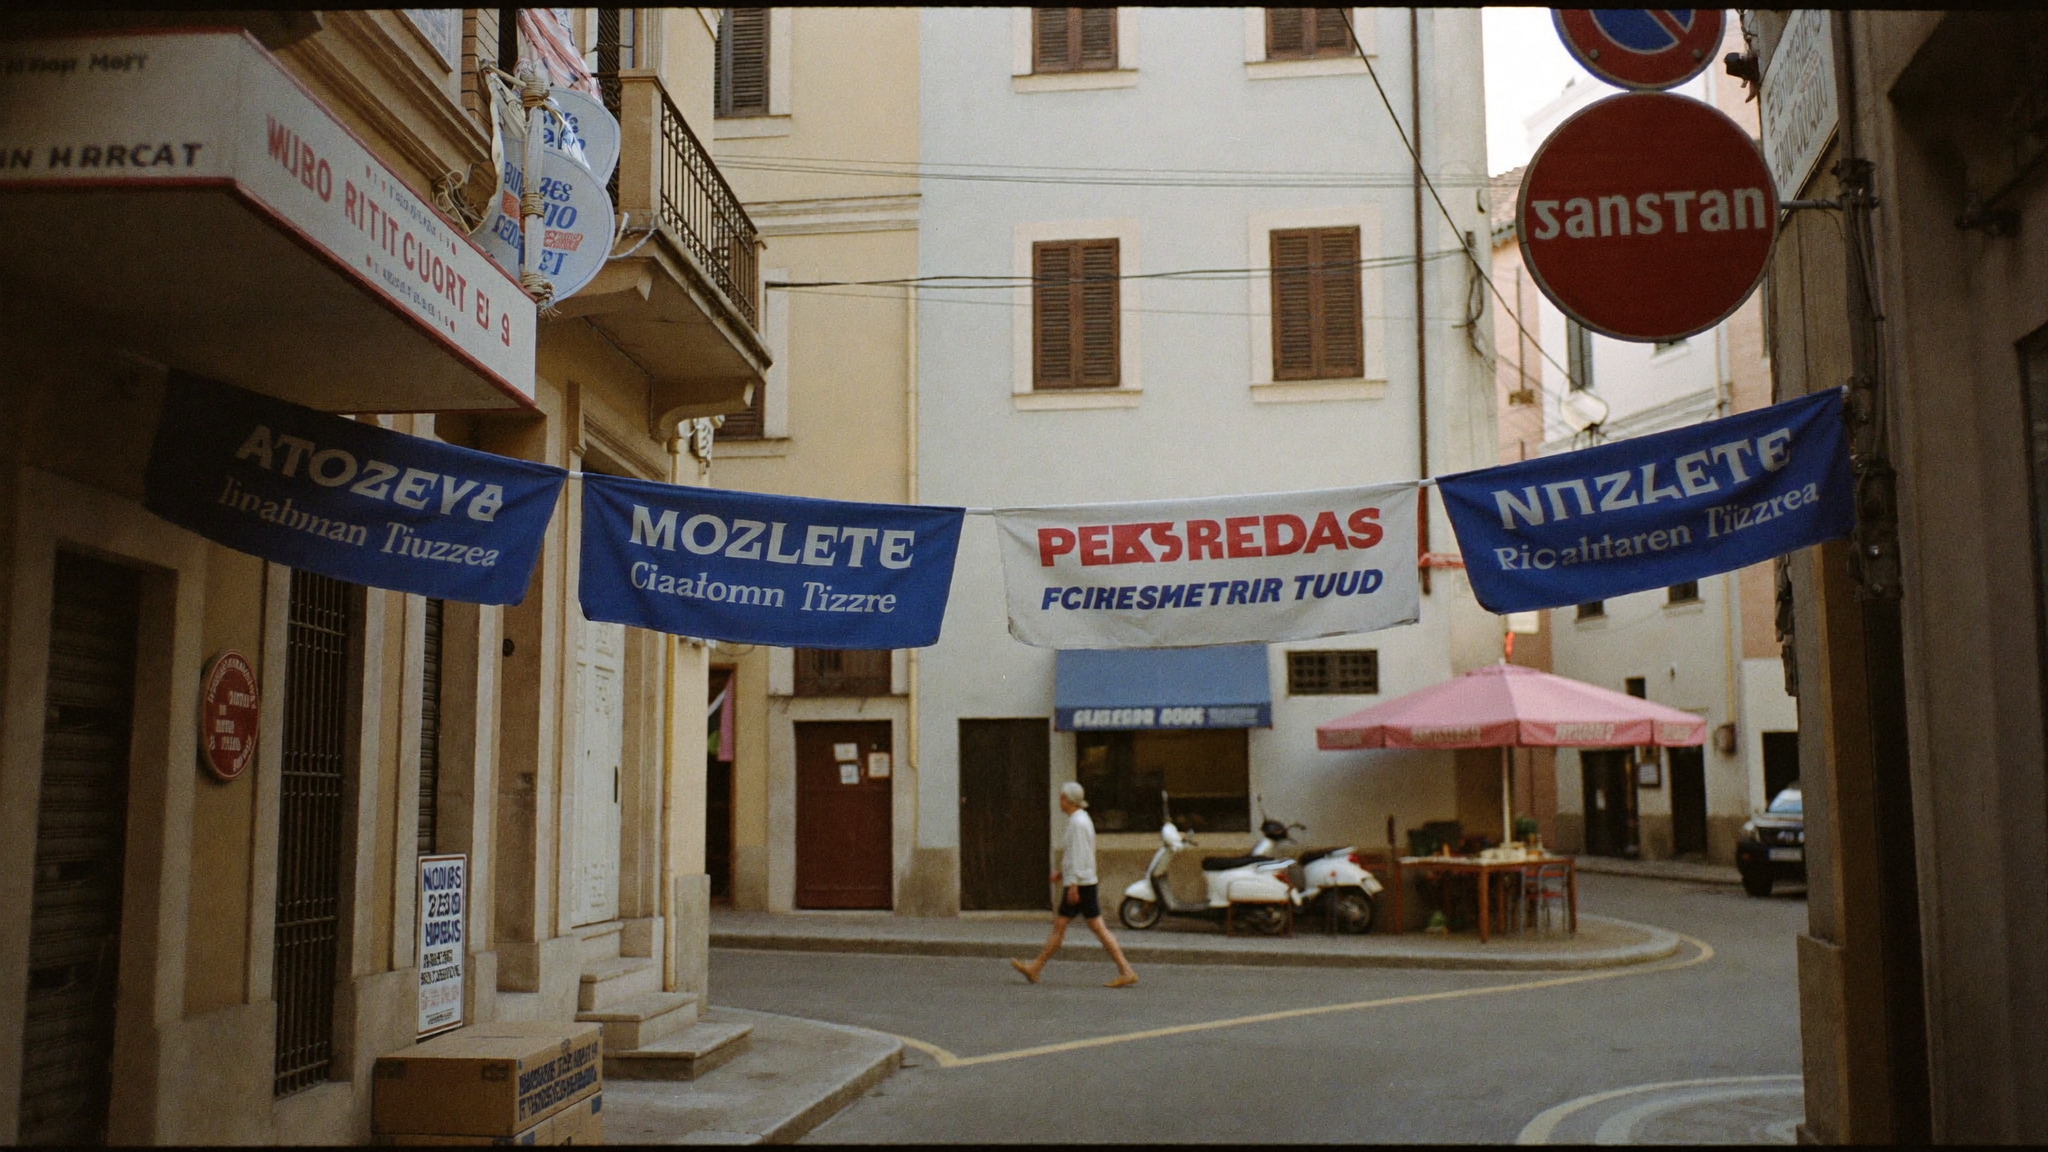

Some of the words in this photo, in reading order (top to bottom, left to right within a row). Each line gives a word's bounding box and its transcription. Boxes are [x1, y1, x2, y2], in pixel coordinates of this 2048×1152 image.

[628, 503, 915, 571] MOZLETE
[801, 581, 897, 614] Tizzre
[1294, 568, 1384, 600] TUUD
